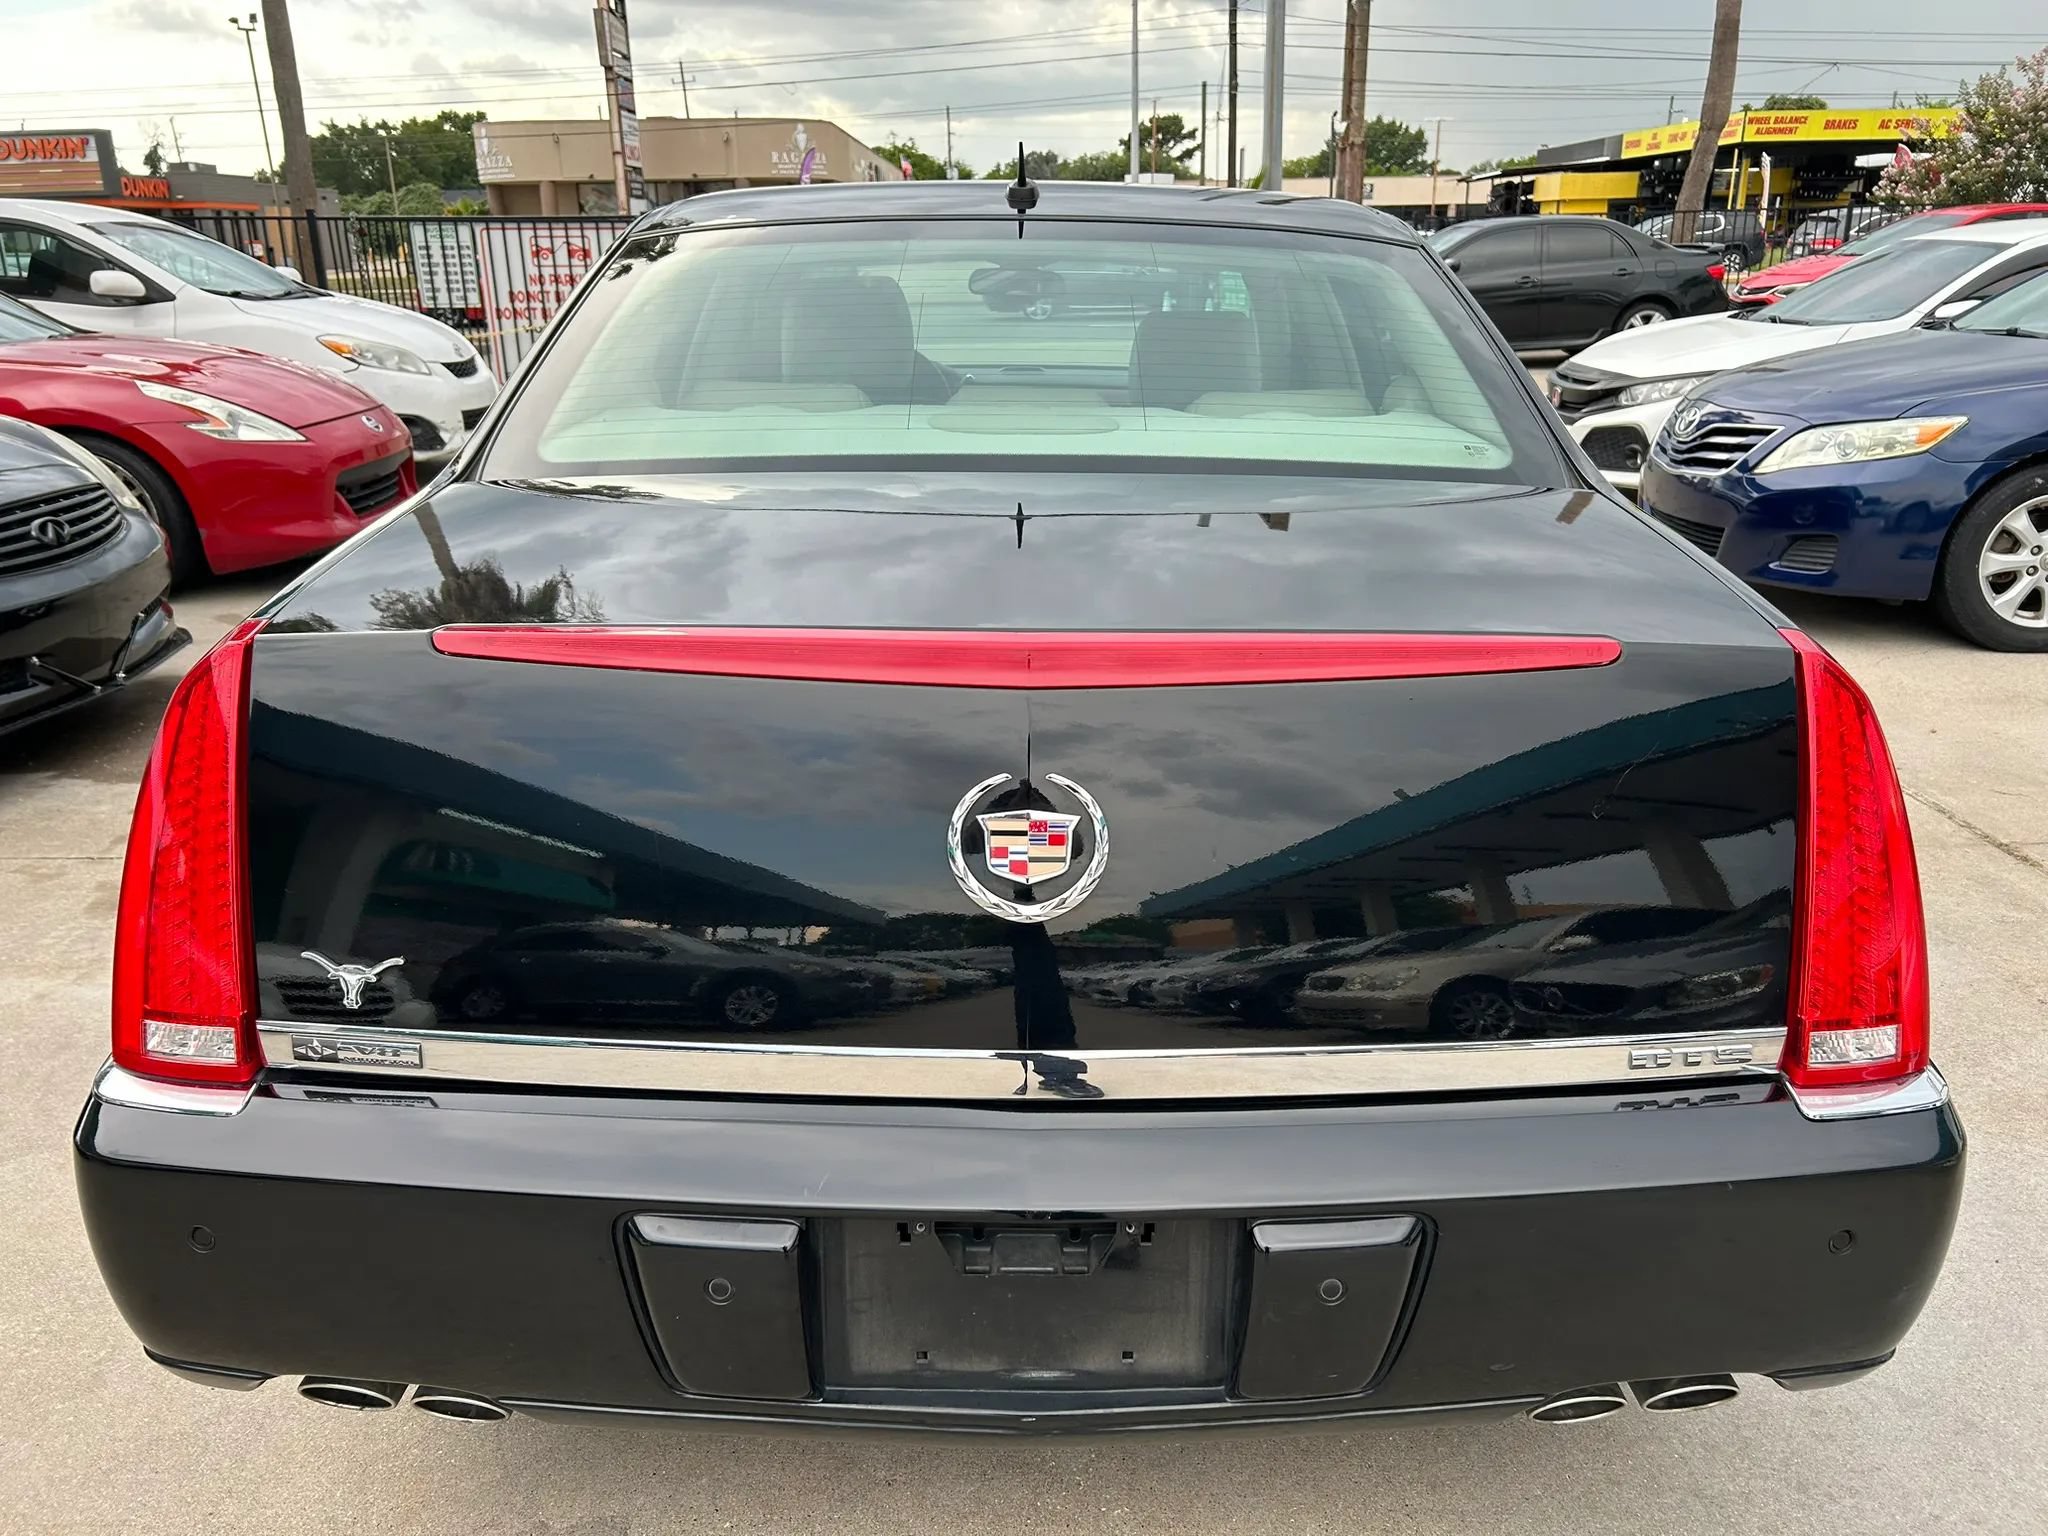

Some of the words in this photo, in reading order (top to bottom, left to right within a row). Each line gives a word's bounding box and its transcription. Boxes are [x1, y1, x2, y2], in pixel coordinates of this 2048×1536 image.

[1747, 117, 1771, 125] WHEEL
[1773, 116, 1808, 125] BALANCE
[1823, 119, 1859, 130] BRAKES
[1878, 119, 1891, 130] AC
[1754, 126, 1799, 135] ALIGNMENT
[121, 176, 170, 198] DUNKIN
[528, 274, 546, 286] NO
[527, 290, 551, 303] NOT
[514, 307, 538, 320] NOT
[1628, 1044, 1753, 1070] DTS
